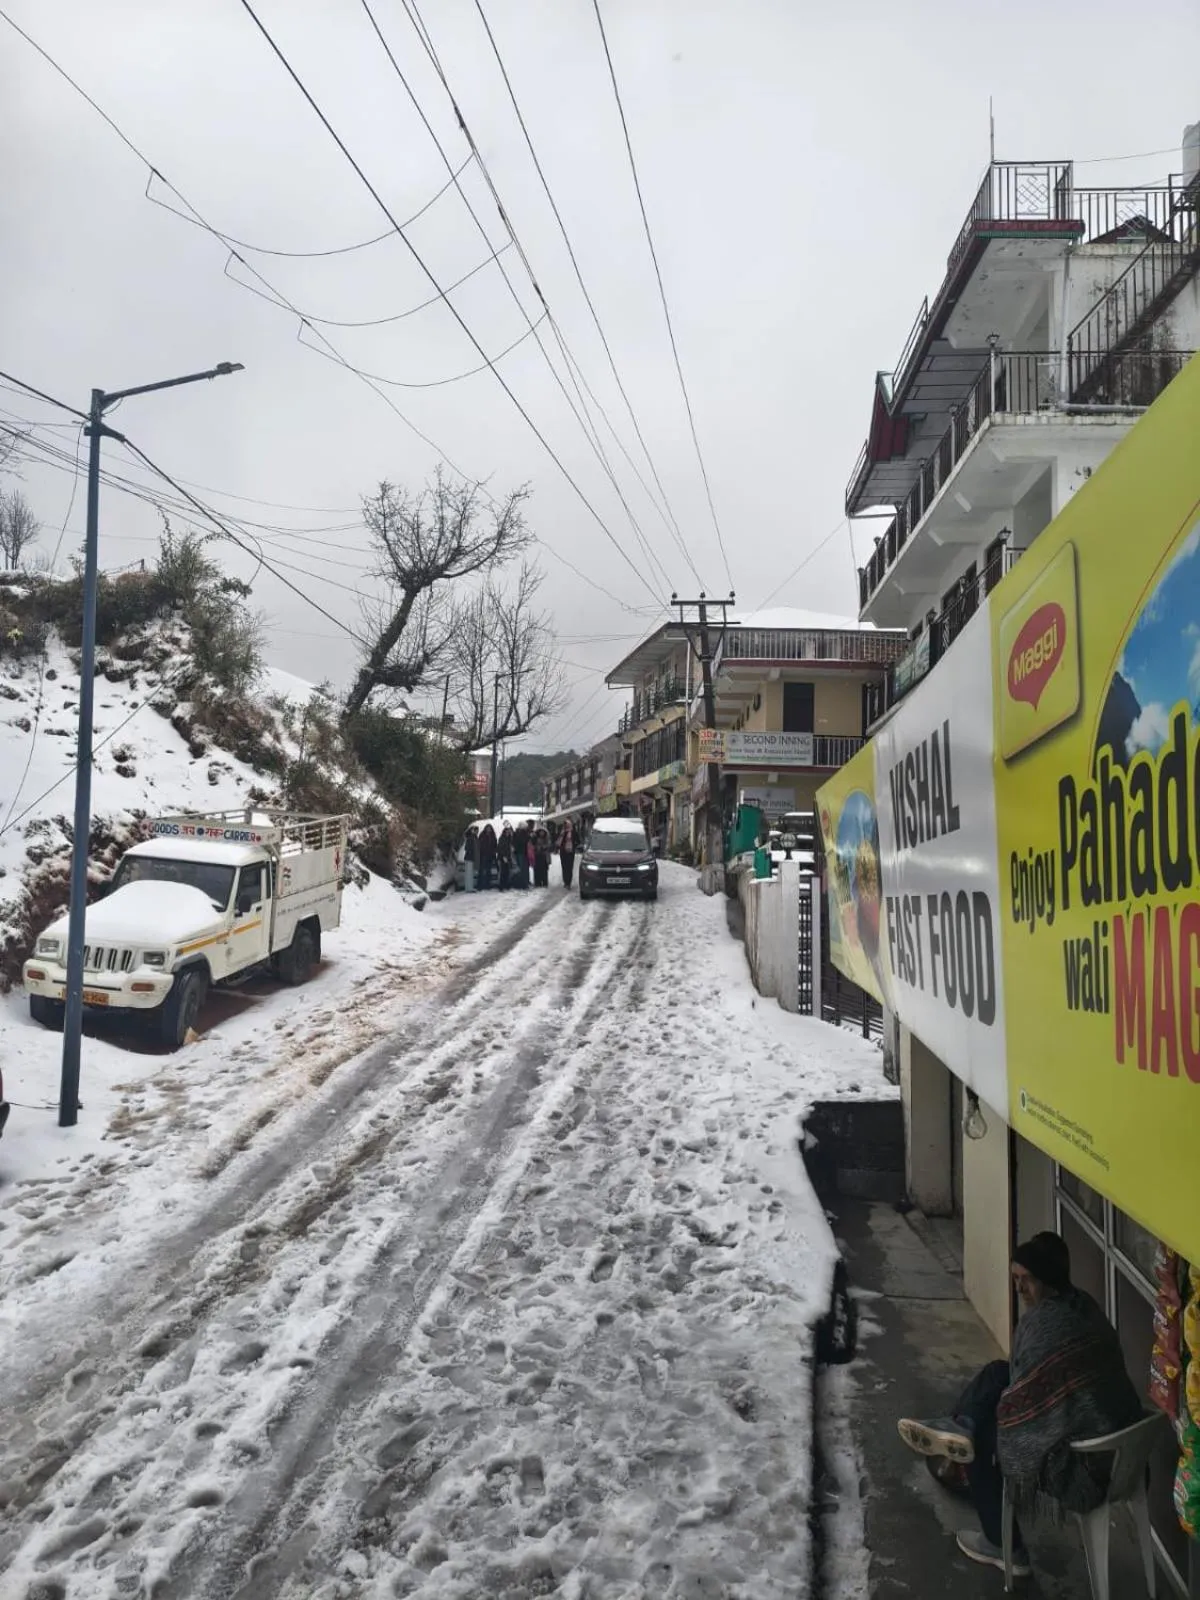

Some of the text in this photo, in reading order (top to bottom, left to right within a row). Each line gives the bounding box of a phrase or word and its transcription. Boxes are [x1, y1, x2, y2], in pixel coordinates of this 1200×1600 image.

[1013, 617, 1058, 685] Maggi
[743, 734, 777, 745] SECOND
[889, 718, 960, 852] VISHAL
[1010, 711, 1200, 935] enjoy Pahad
[148, 822, 180, 835] GOODS
[223, 829, 256, 841] CARRIER
[886, 889, 996, 1027] FAST FOOD
[1063, 920, 1110, 1015] wali
